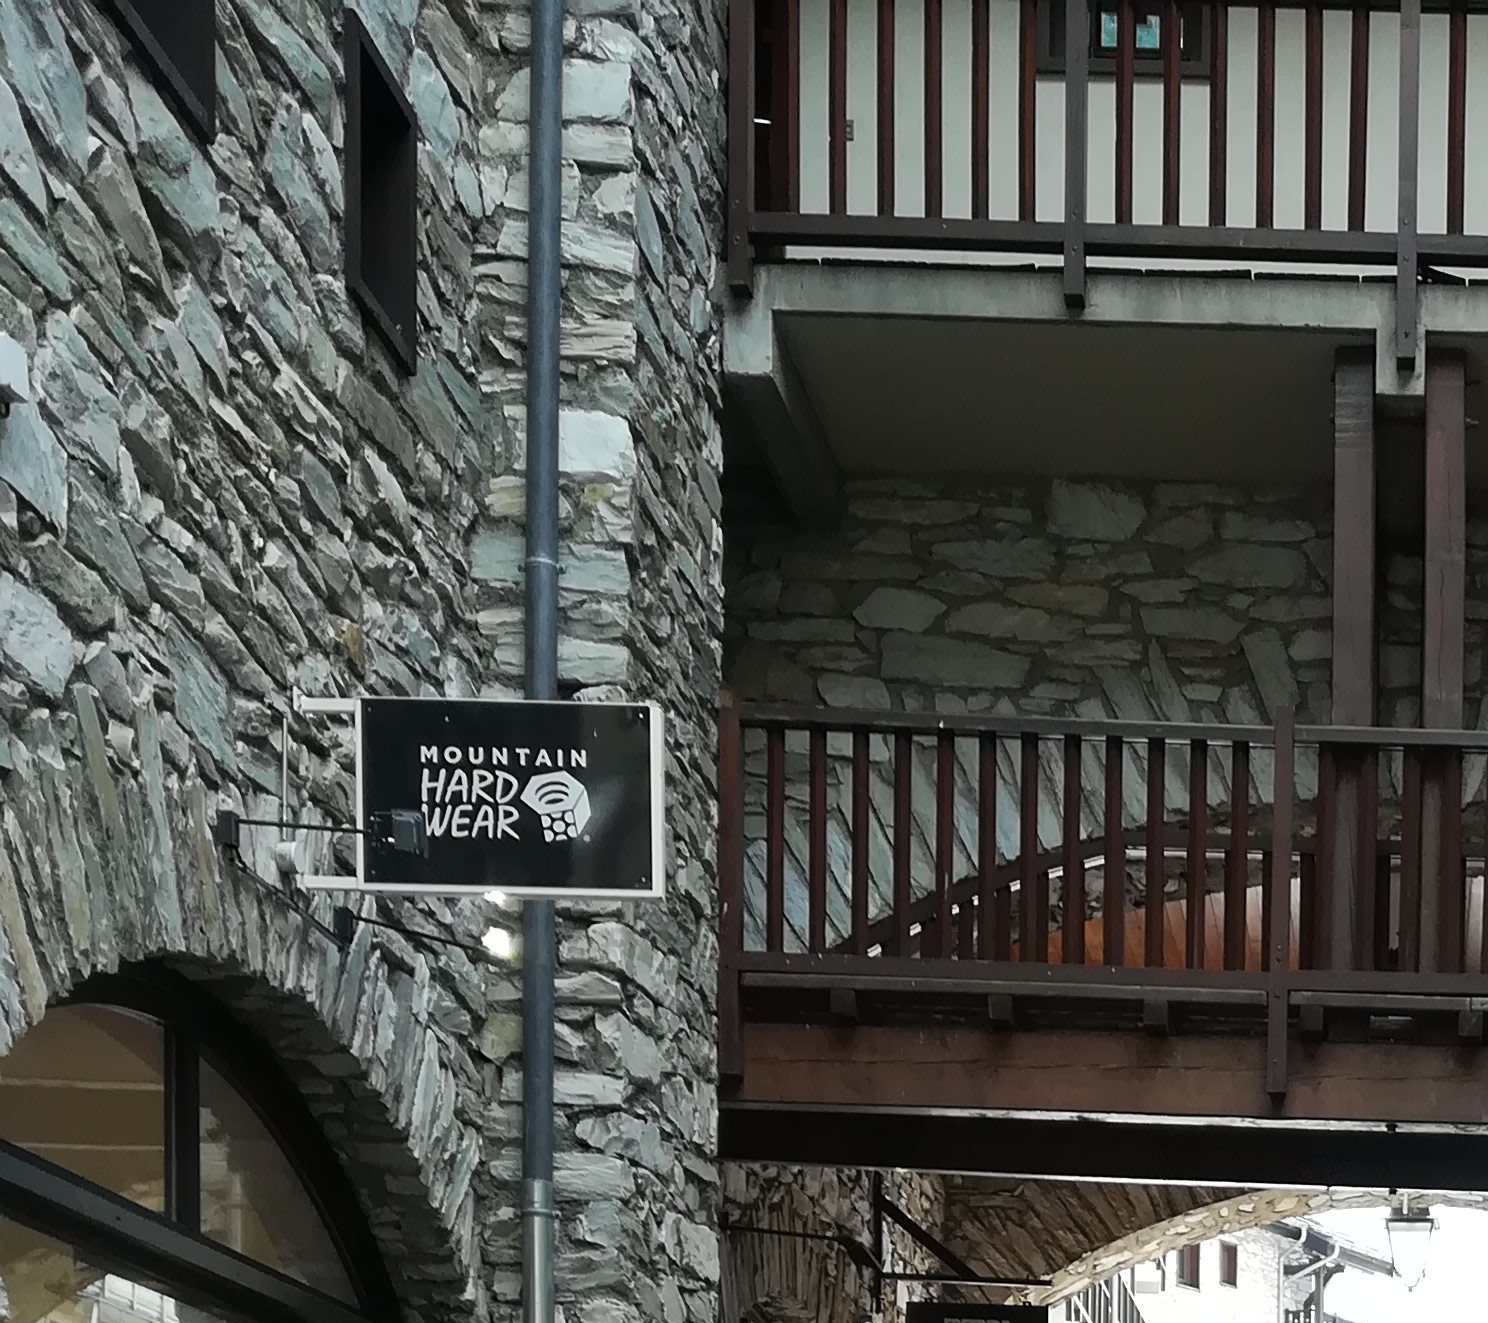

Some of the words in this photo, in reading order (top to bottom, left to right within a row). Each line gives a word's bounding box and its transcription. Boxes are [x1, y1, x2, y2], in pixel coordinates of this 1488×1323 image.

[420, 745, 588, 768] MOUNTAIN
[421, 768, 519, 804] HARD
[421, 803, 520, 840] WEAR
